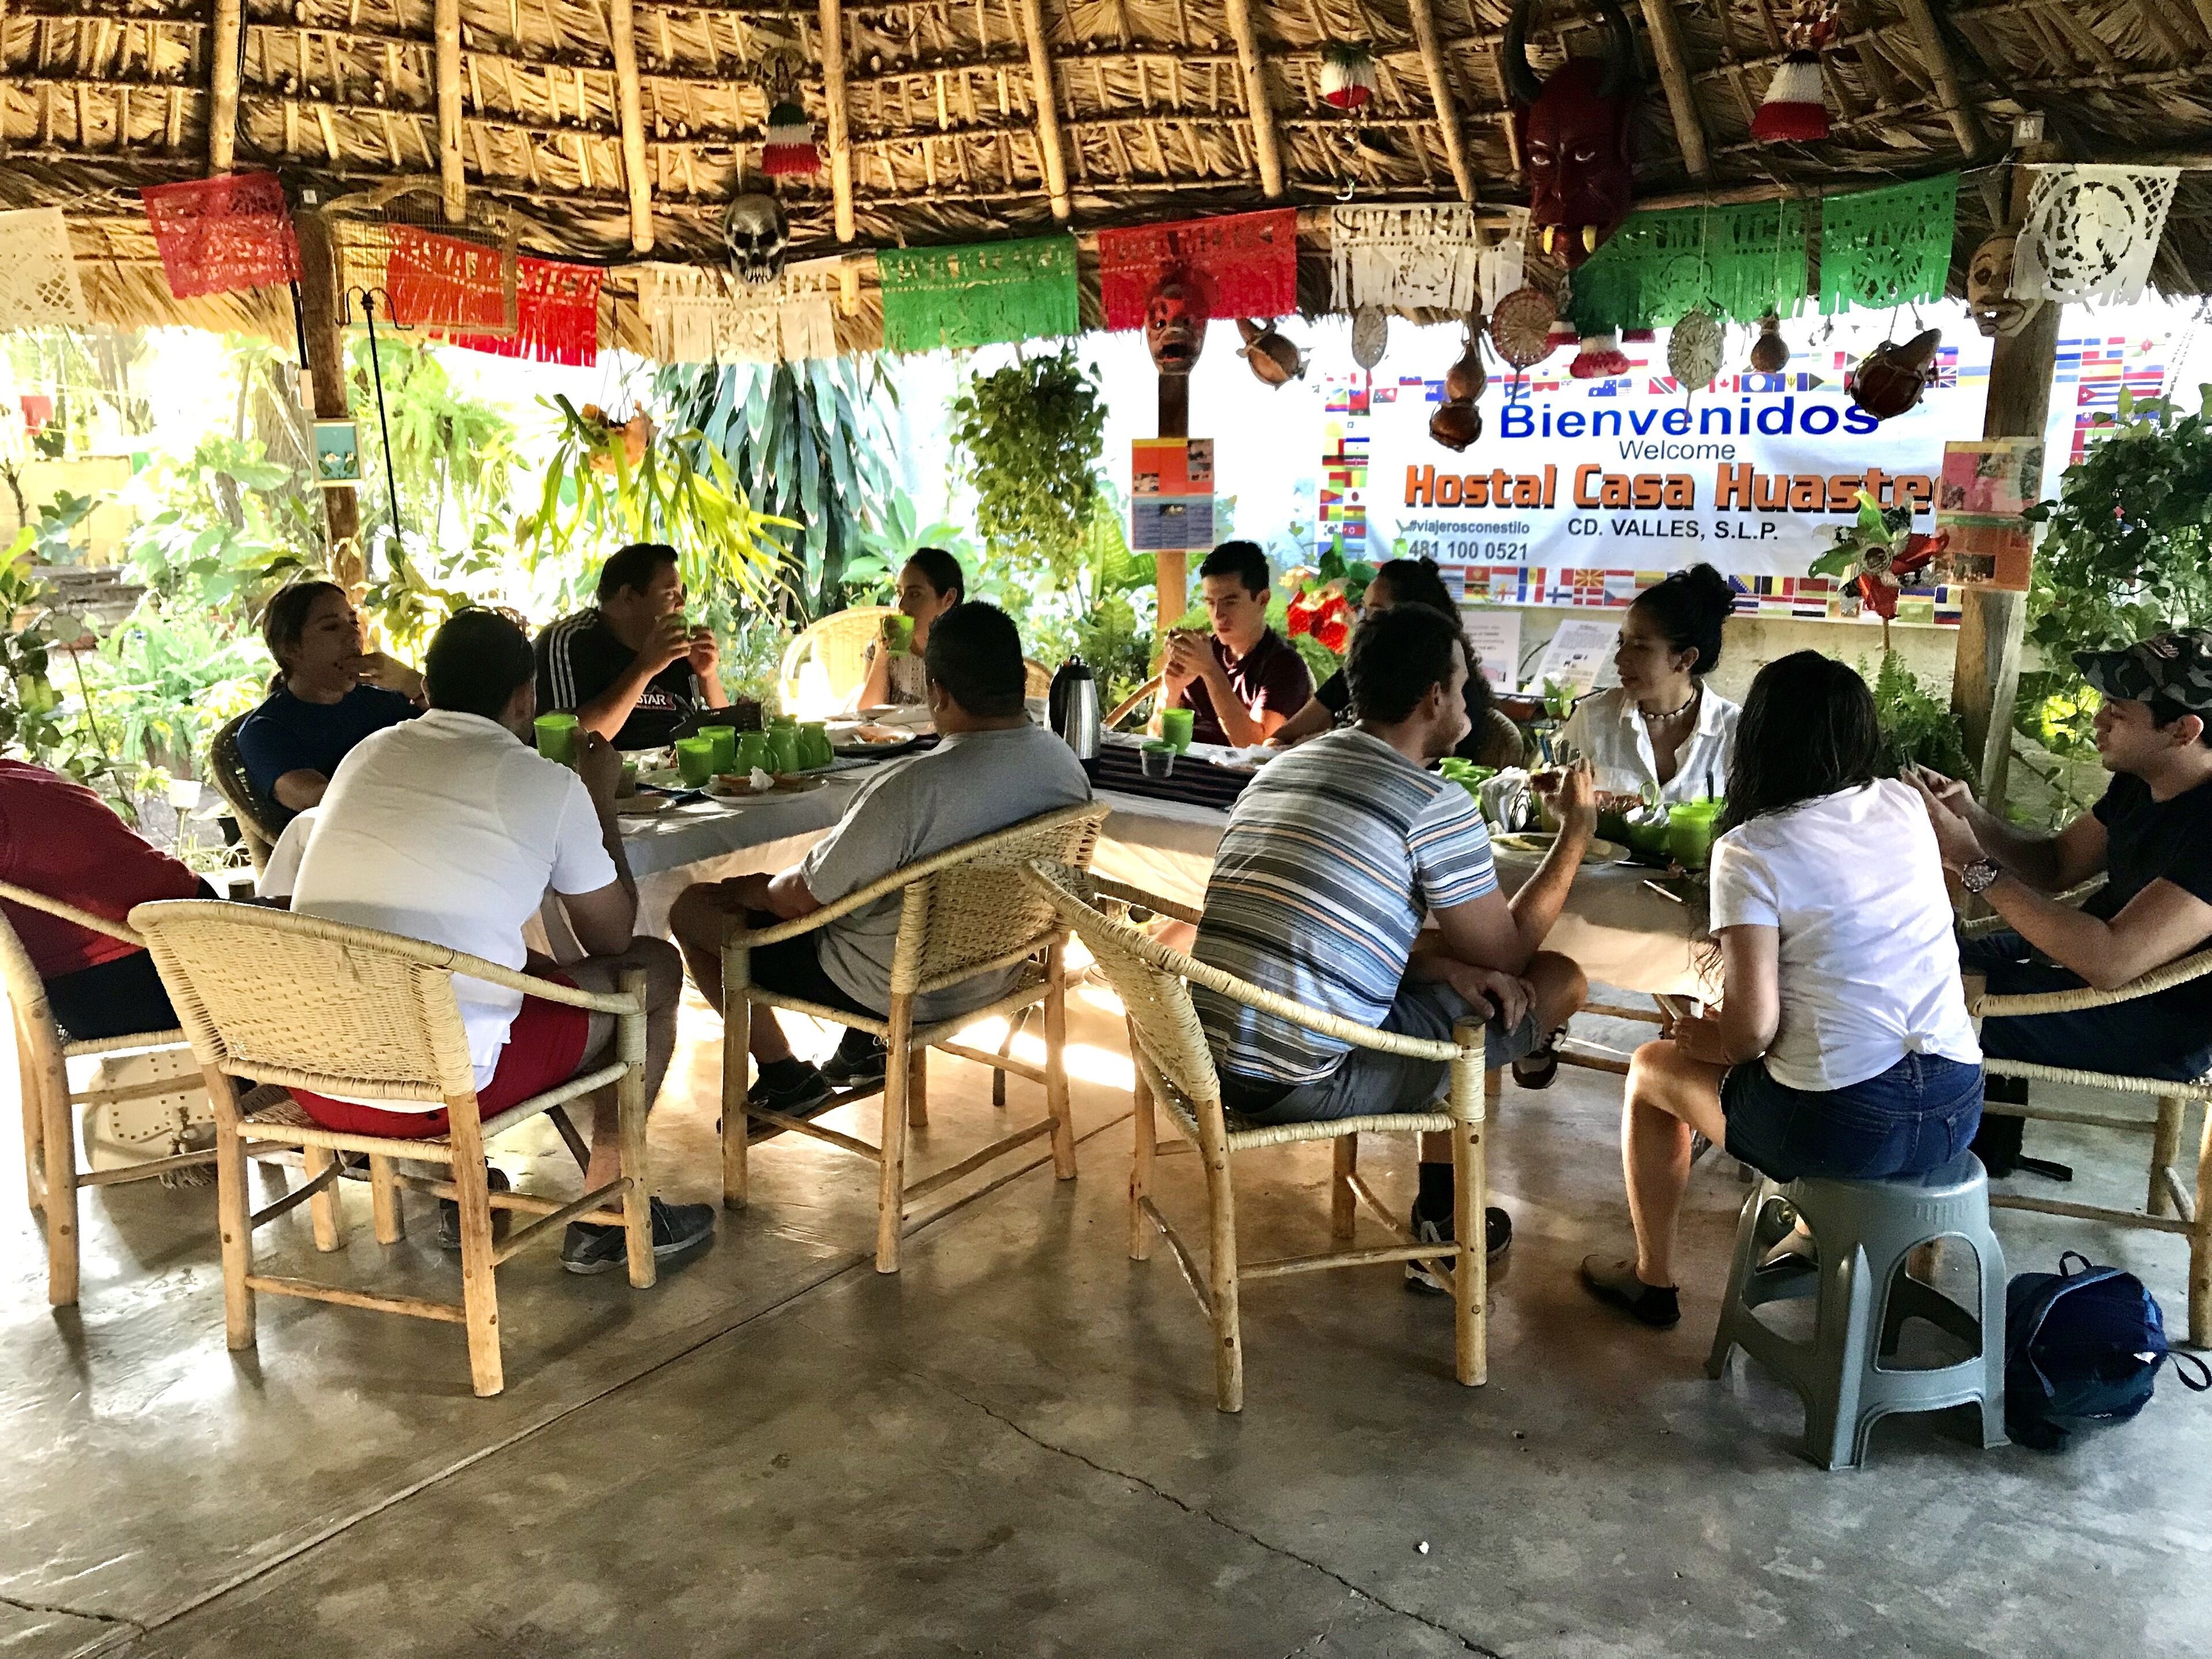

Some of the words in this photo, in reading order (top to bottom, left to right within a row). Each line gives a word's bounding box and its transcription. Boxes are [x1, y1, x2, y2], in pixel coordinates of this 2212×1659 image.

[1500, 396, 1880, 438] Bienvenidos
[1619, 440, 1736, 461] Welcome
[1404, 463, 1558, 509] Hostal
[1573, 463, 1695, 510] Casa
[1714, 462, 1941, 515] Huaste
[1410, 519, 1530, 535] #viajerosconestilo
[1567, 518, 1603, 536] CD.
[1612, 518, 1706, 541] VALLES,
[1714, 521, 1779, 540] S.L.P.
[1409, 540, 1440, 558] 481
[1447, 541, 1479, 559] 100
[1485, 542, 1528, 560] 0521
